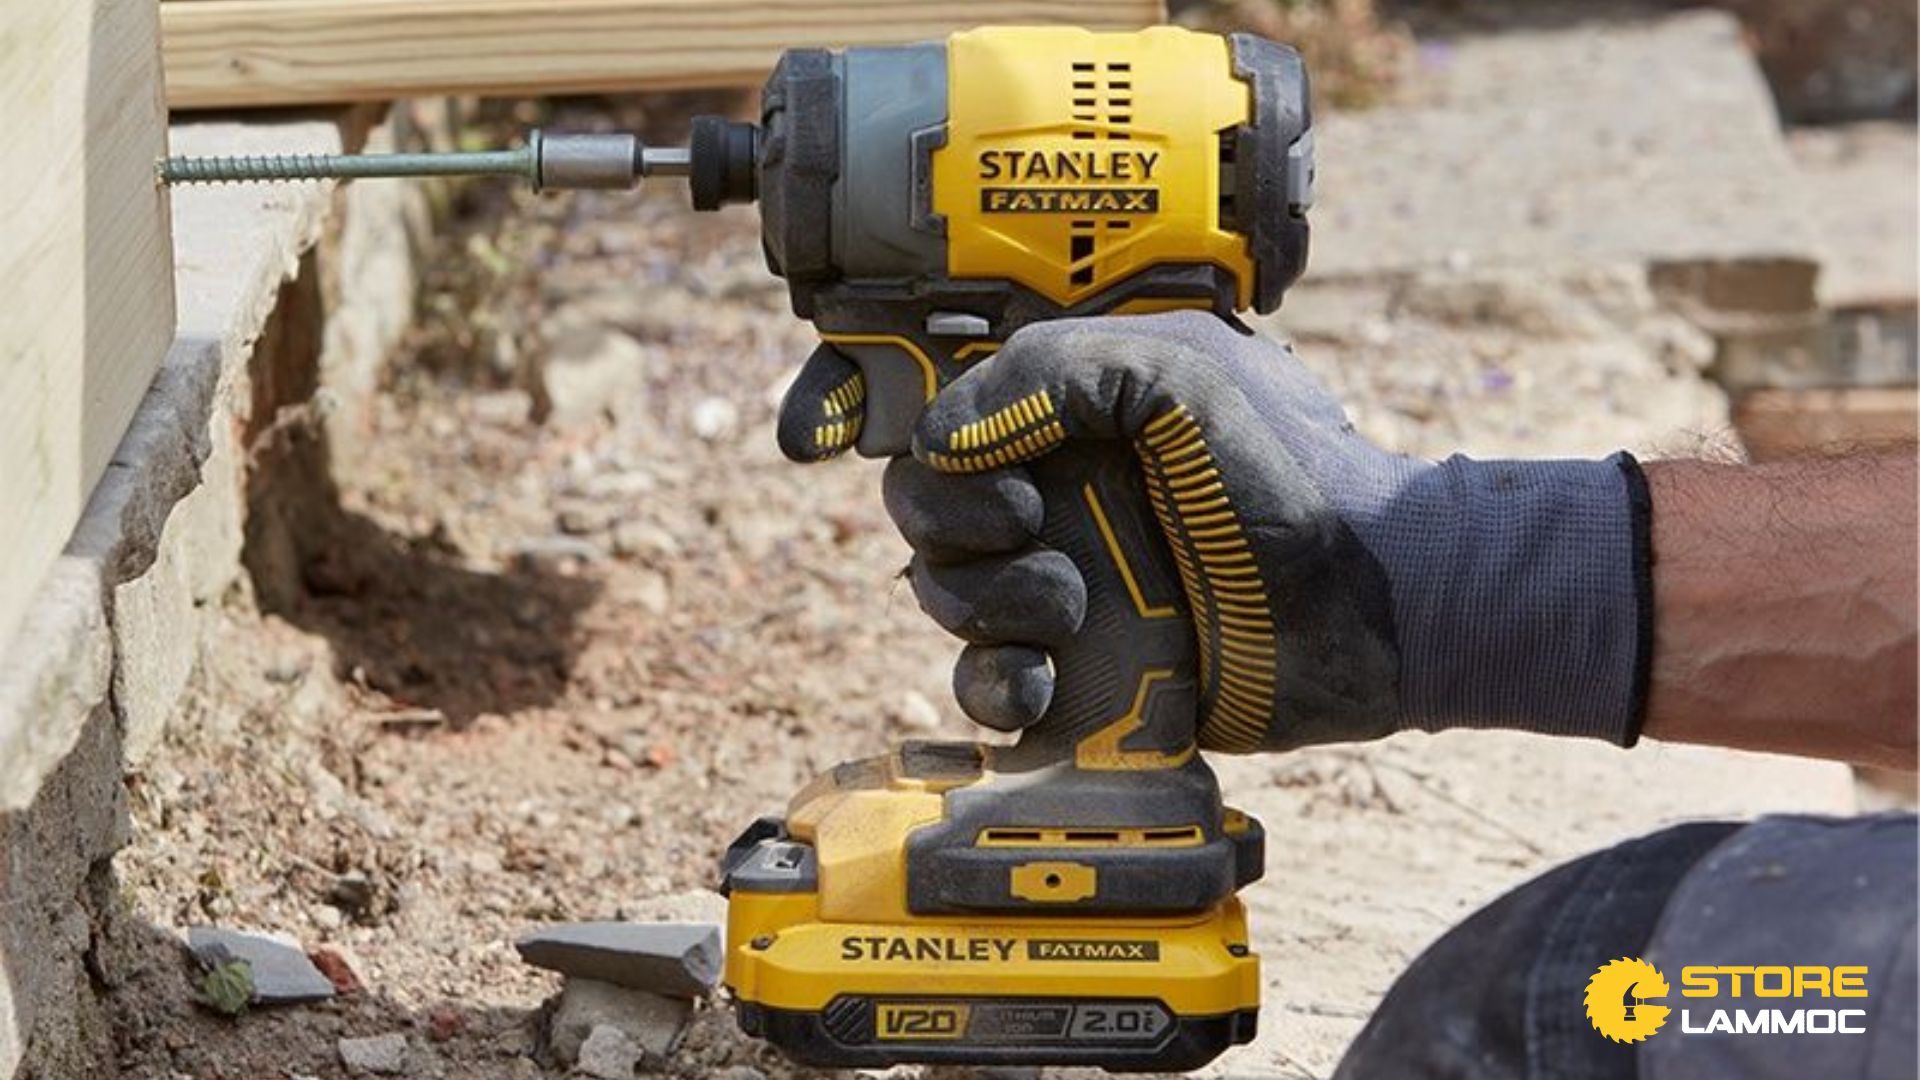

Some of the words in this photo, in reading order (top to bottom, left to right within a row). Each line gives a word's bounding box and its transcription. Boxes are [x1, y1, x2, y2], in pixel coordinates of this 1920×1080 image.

[980, 151, 1158, 178] STANLEY
[990, 191, 1151, 210] FATMAX
[840, 937, 1017, 961] STANLEY
[1037, 942, 1146, 958] FATMAX
[886, 1010, 957, 1034] V20
[1083, 1010, 1140, 1033] 2.0
